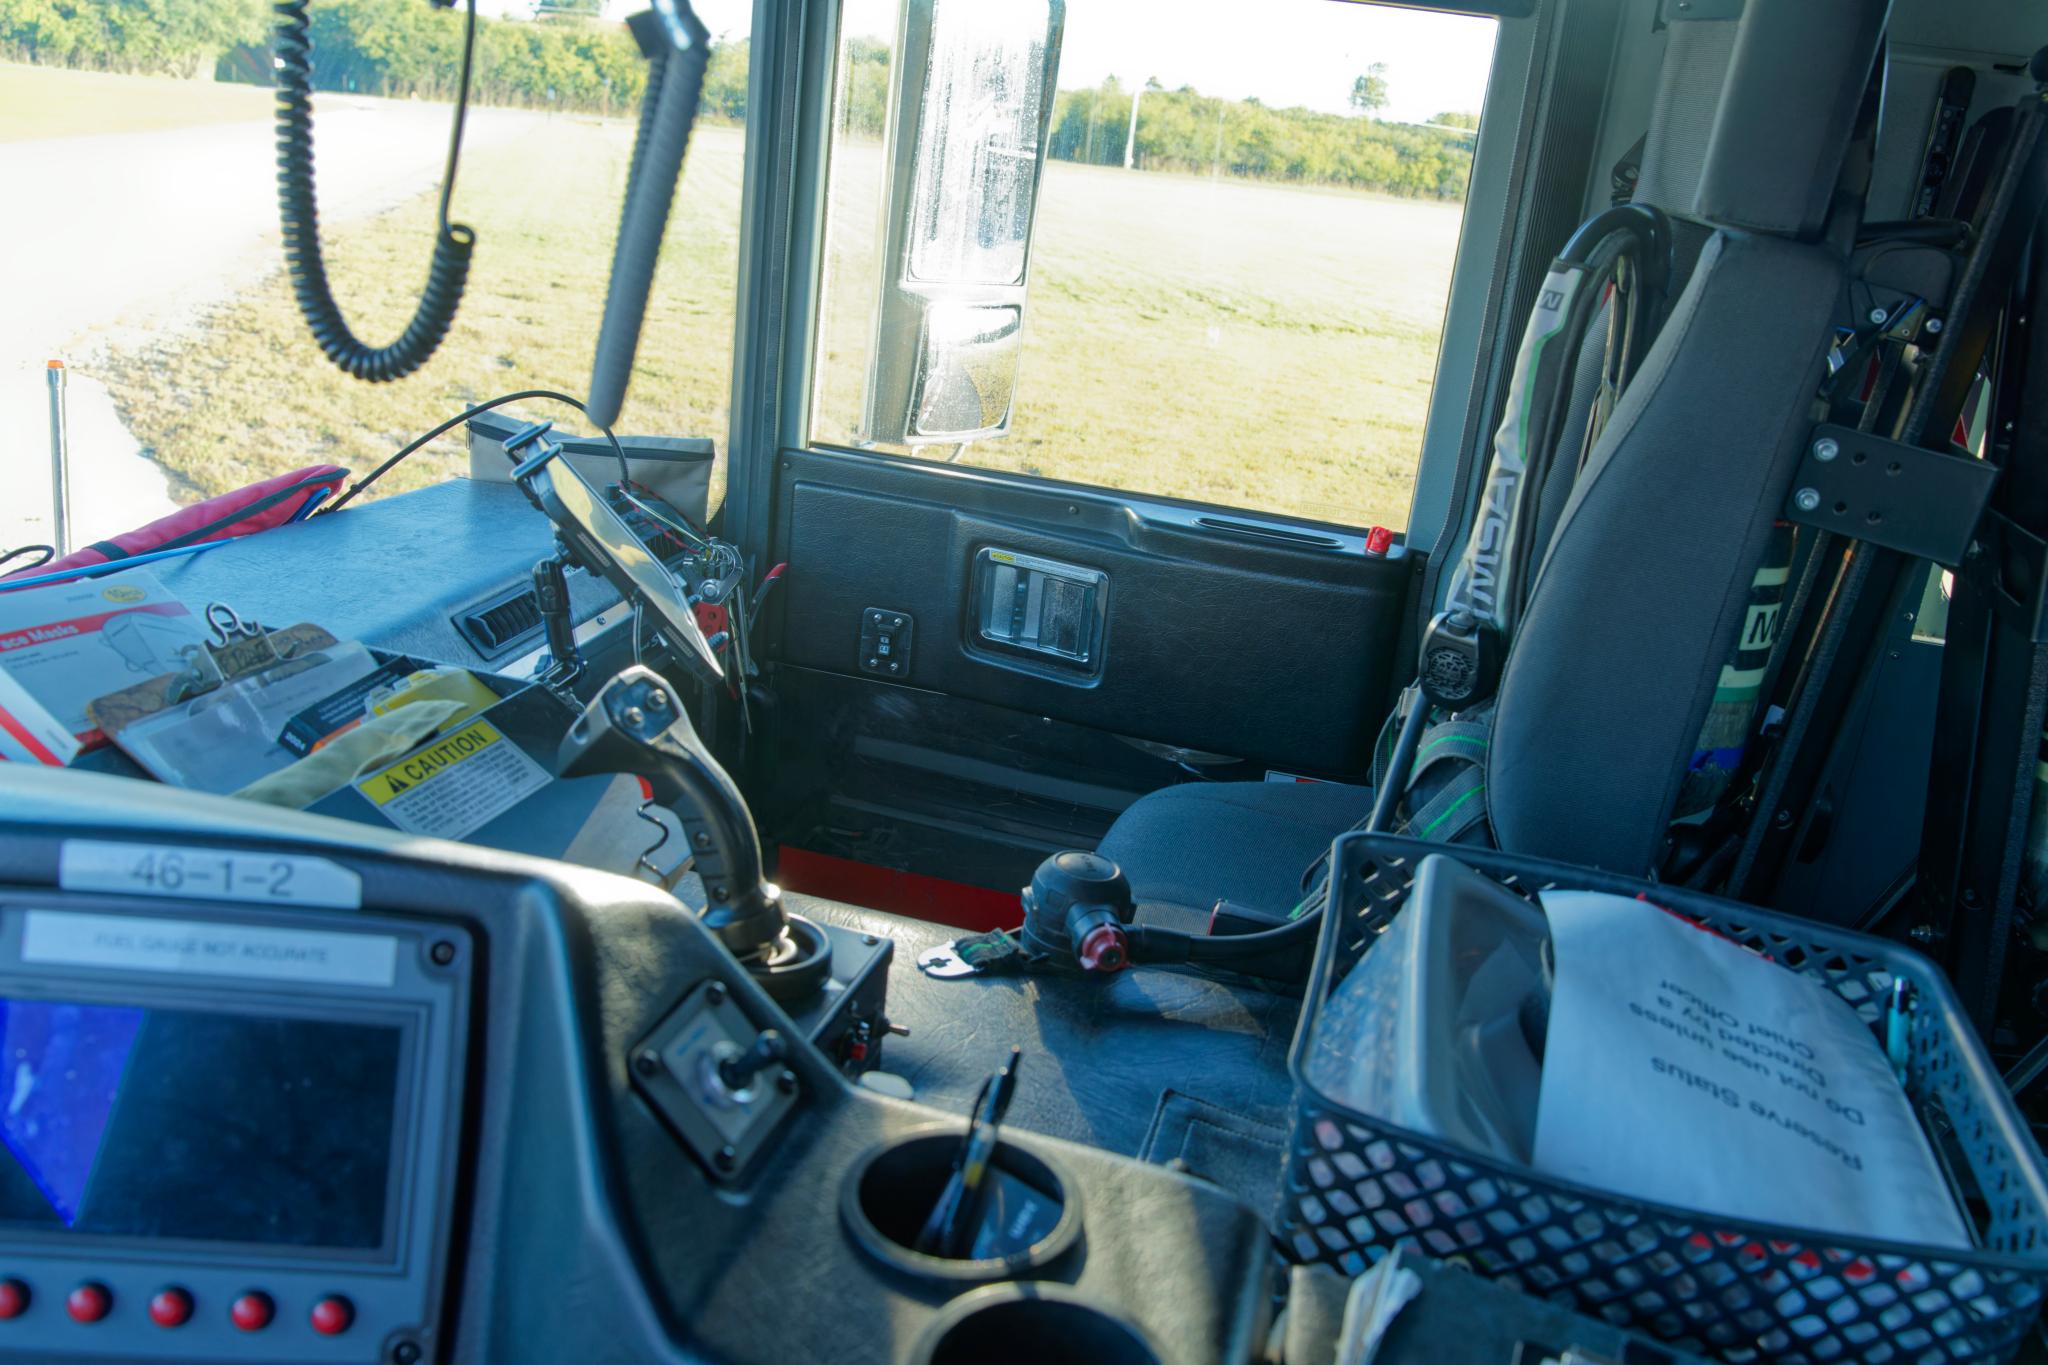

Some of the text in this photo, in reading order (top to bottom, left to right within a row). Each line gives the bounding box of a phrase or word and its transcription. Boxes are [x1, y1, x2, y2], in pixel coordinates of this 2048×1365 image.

[1465, 475, 1516, 622] MSA
[29, 623, 80, 643] Masks
[404, 729, 489, 781] CAUTION
[129, 852, 296, 898] 46-1-2
[1657, 996, 1826, 1088] Directed by a
[1659, 979, 1815, 1060] Chief Officer
[1628, 1001, 1866, 1126] Do not use unless
[1650, 1056, 1863, 1171] Reserve Status
